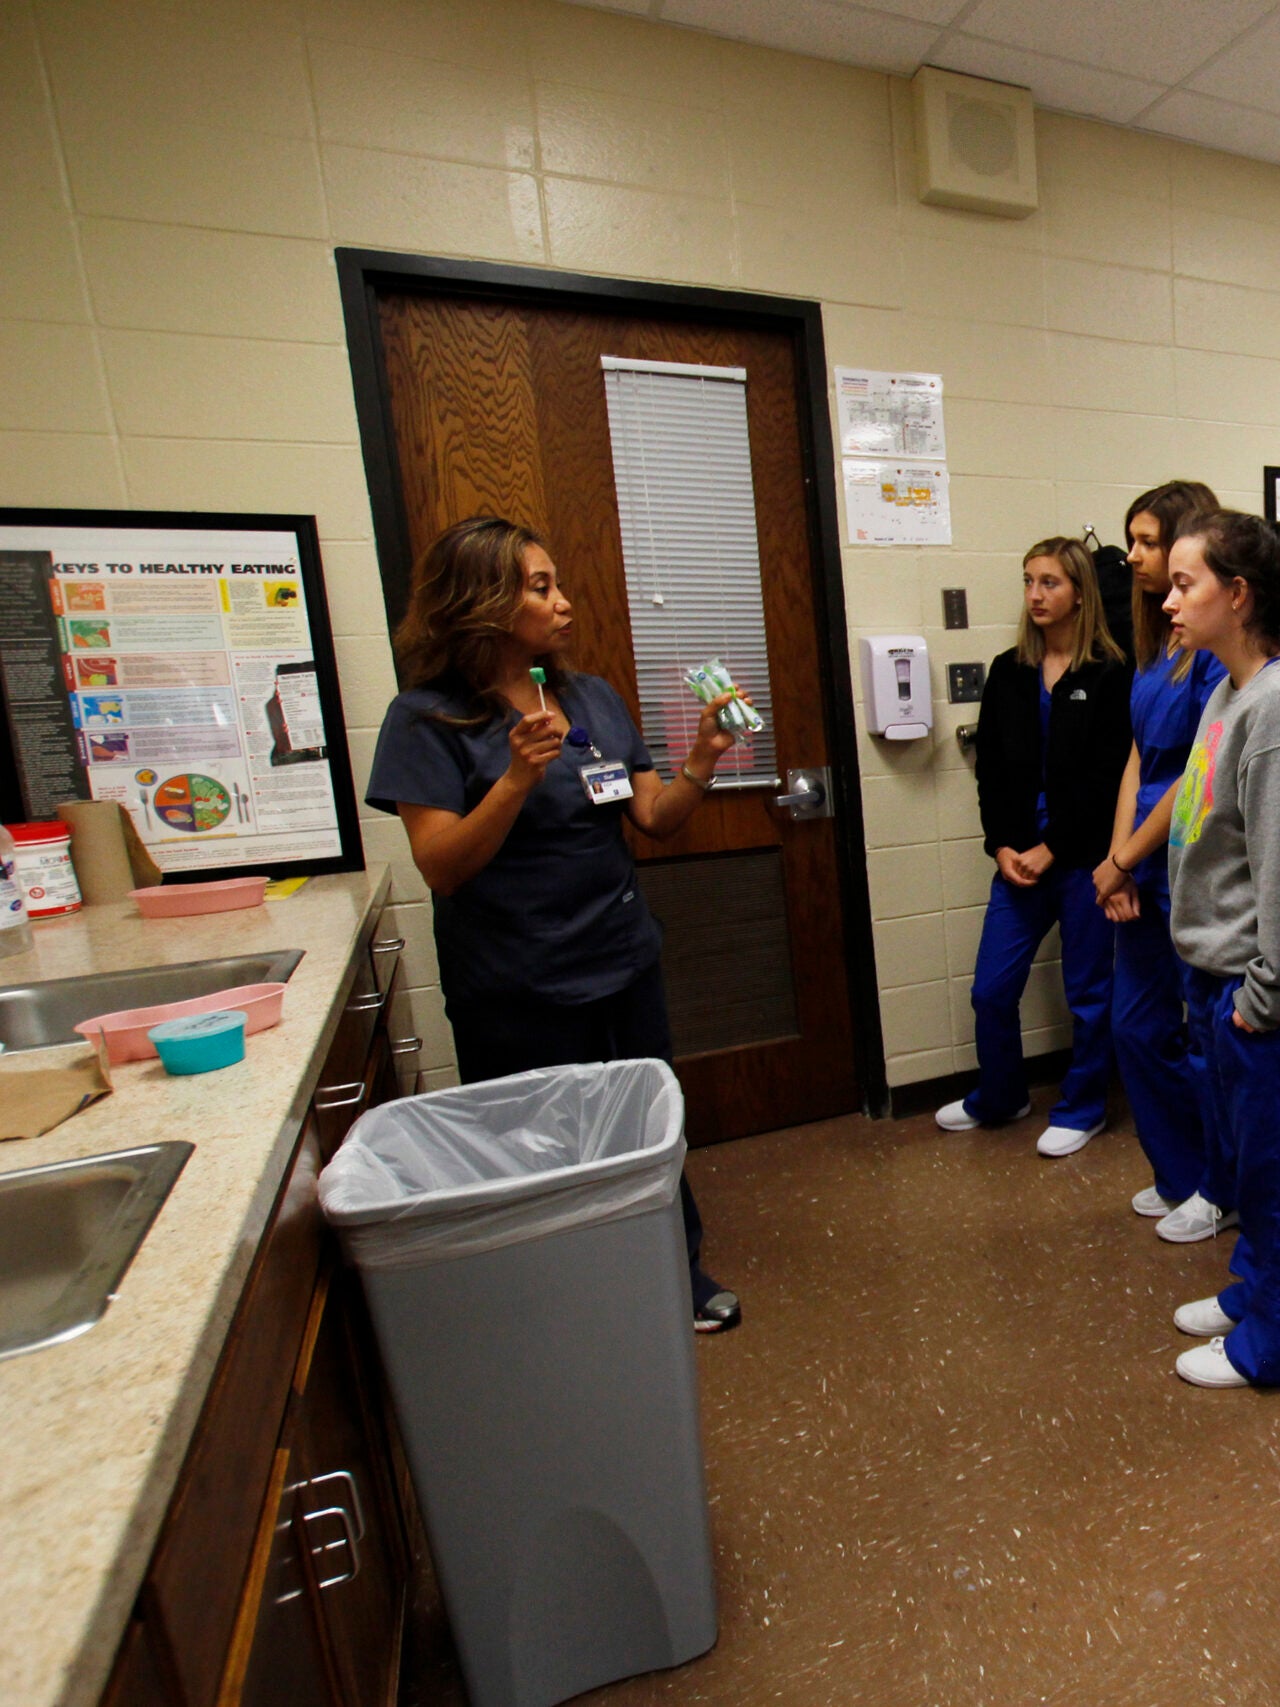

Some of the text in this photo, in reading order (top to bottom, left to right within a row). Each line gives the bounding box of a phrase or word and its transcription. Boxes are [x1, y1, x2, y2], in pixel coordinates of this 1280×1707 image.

[53, 563, 296, 574] KEYS TO HEALTHY EATING
